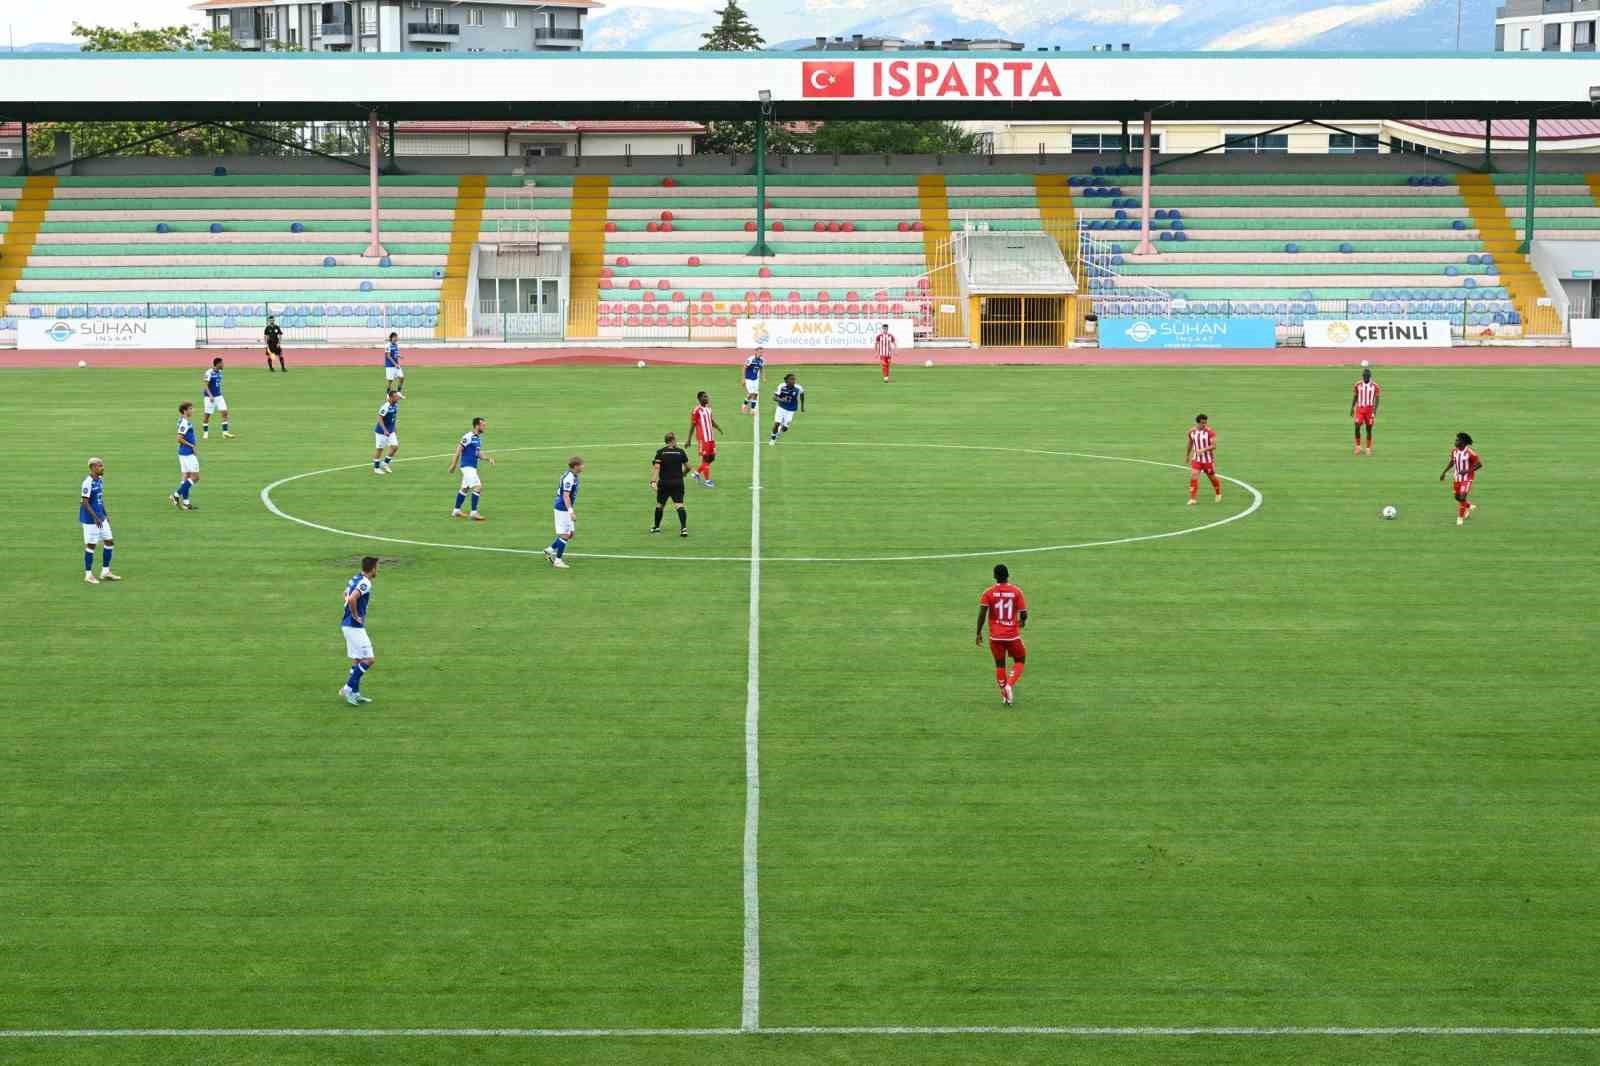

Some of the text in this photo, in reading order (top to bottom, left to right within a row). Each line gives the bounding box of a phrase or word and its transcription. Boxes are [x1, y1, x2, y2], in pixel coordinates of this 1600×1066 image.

[873, 61, 1062, 97] ISPARTA
[792, 321, 833, 333] ANKA
[1355, 321, 1428, 342] ÇETİNLİ
[994, 598, 1013, 620] 11
